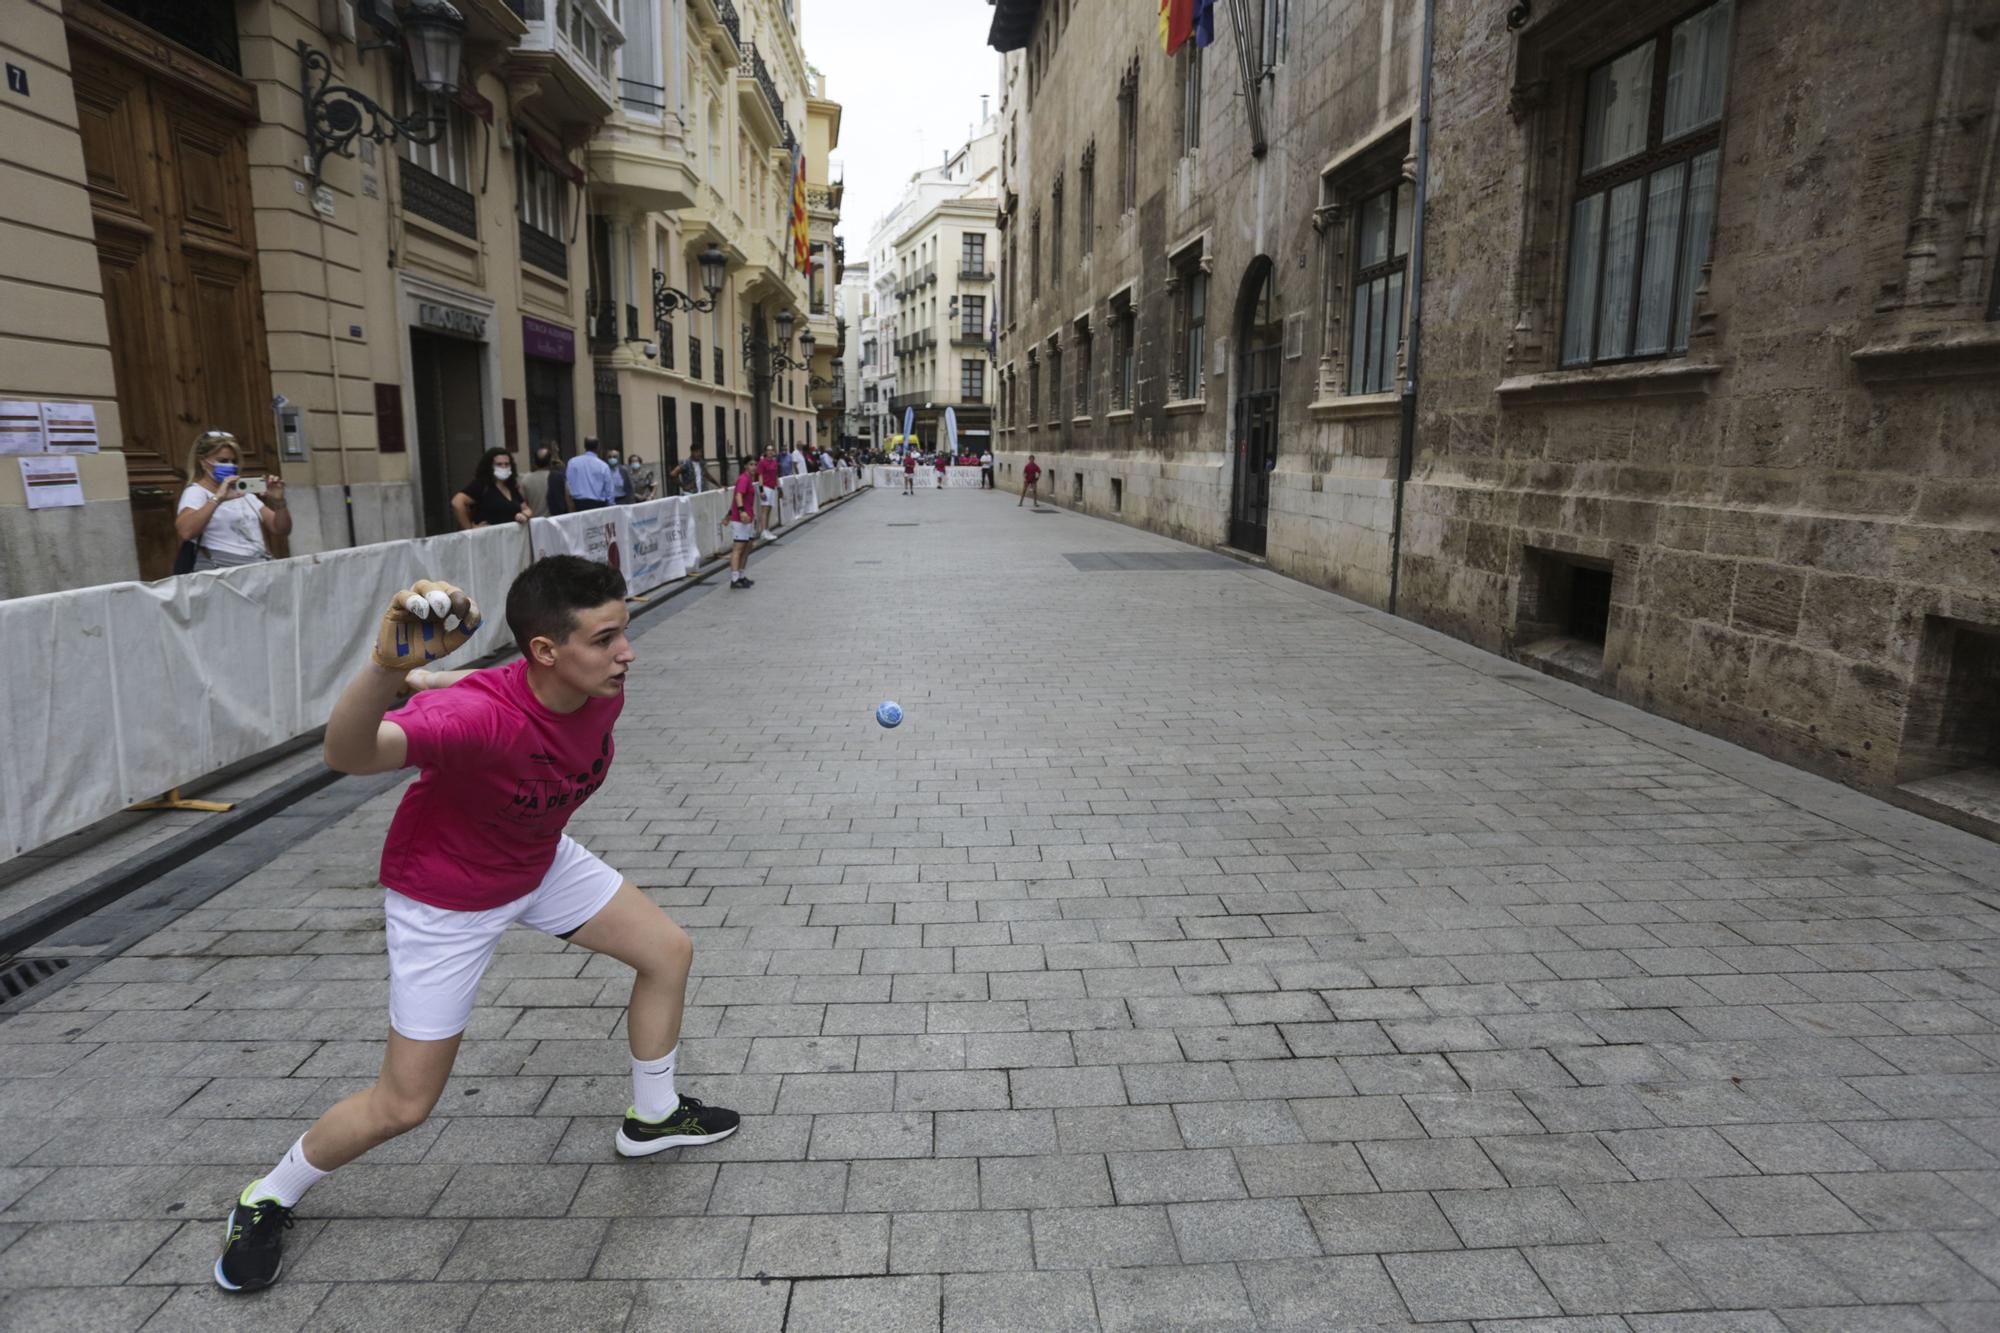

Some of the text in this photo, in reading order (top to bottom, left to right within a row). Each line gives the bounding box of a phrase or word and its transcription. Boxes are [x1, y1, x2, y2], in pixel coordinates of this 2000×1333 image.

[12, 68, 21, 90] 7
[513, 795, 538, 808] VA
[547, 794, 569, 808] DE
